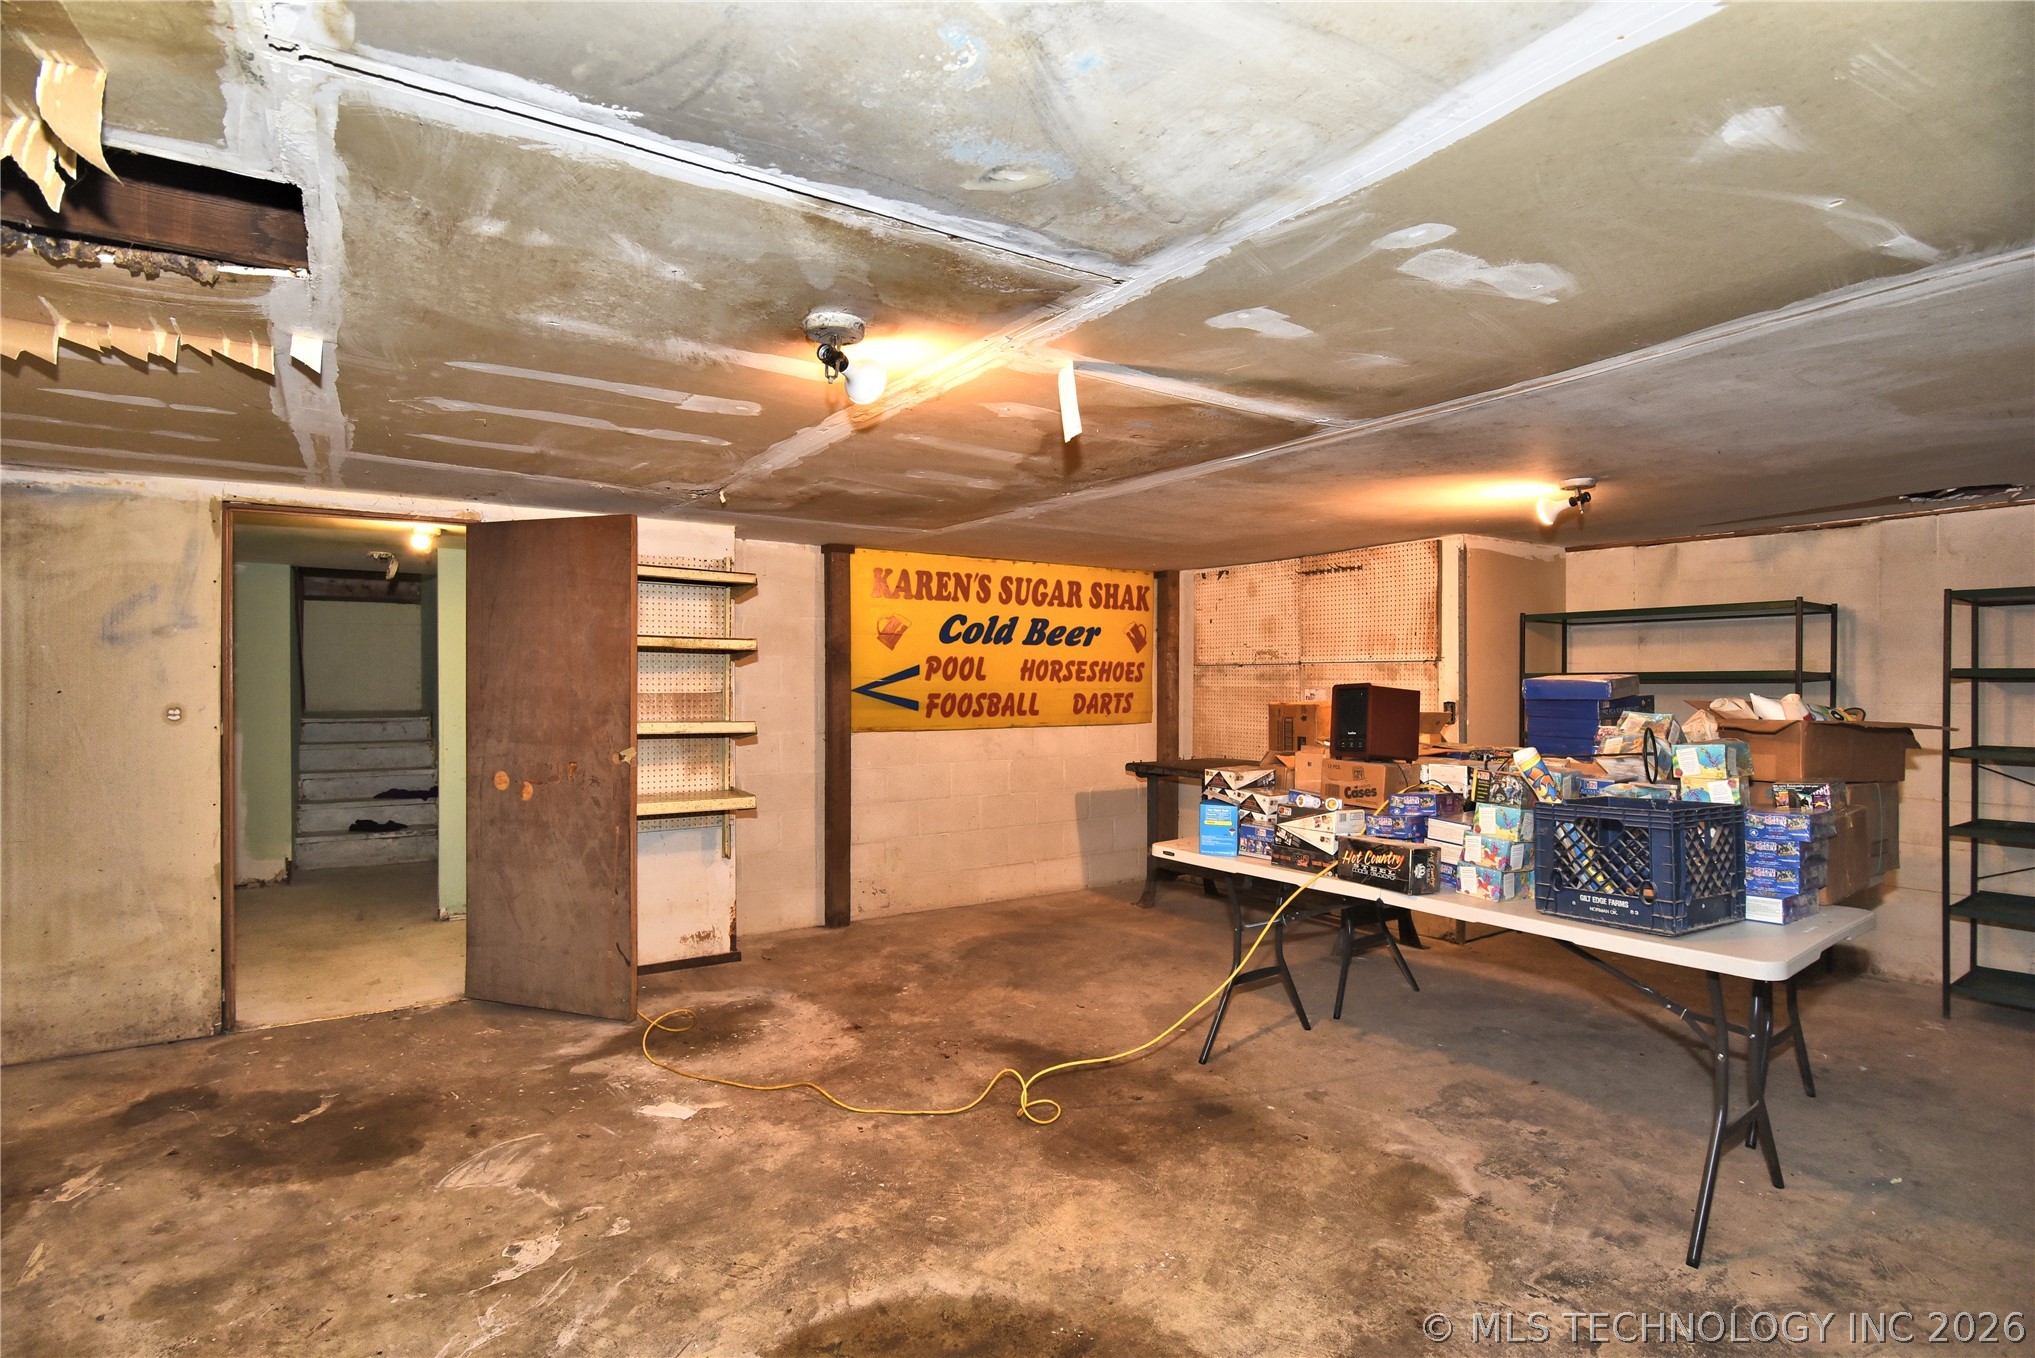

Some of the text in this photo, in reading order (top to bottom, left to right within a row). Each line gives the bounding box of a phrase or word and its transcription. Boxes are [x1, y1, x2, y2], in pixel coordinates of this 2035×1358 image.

[871, 567, 1150, 612] KAREN'S SUGAR SHAK
[939, 613, 1102, 648] Cold Beer
[924, 655, 1145, 684] POOL HORSESHOES
[925, 692, 1134, 718] FOOSBALL DARTS
[1344, 786, 1378, 799] Cases
[1342, 850, 1363, 864] Hot
[1364, 850, 1405, 869] Country
[1580, 894, 1629, 908] GILT EDGE FARMS
